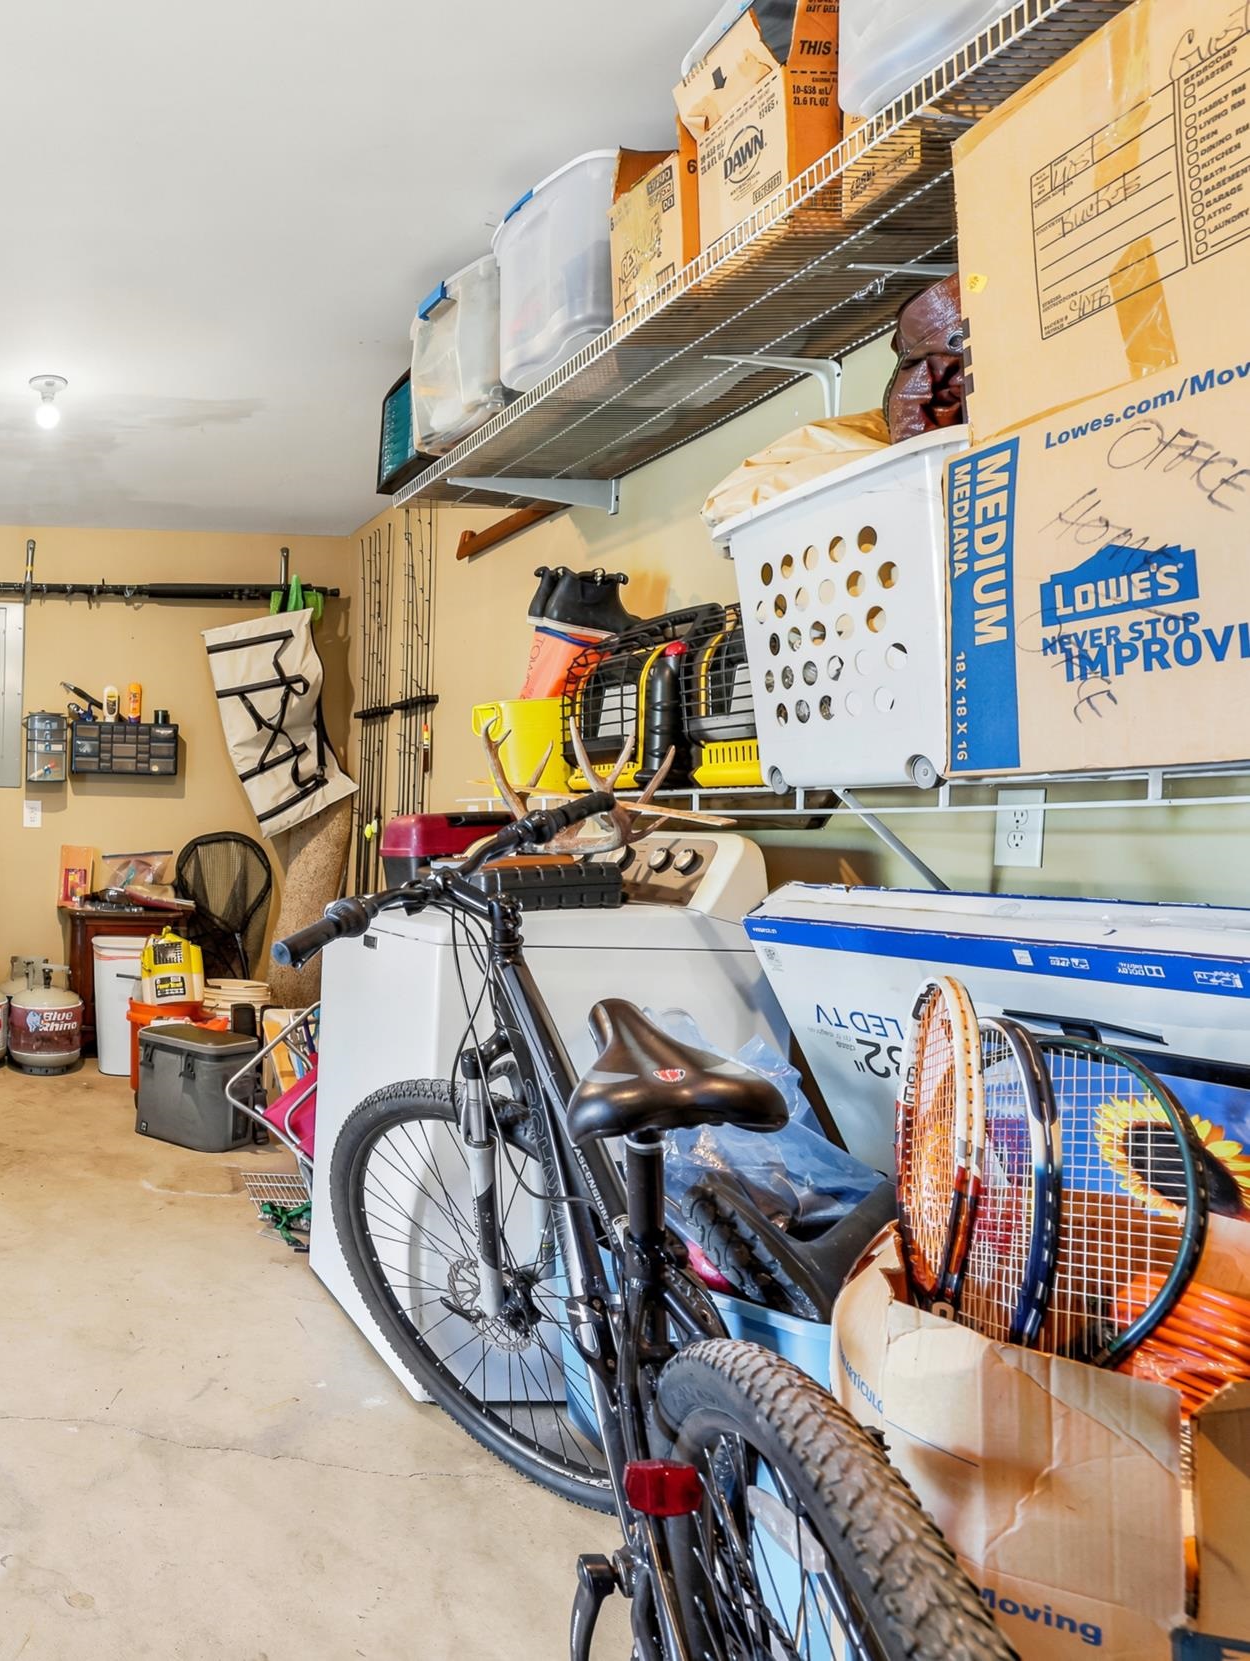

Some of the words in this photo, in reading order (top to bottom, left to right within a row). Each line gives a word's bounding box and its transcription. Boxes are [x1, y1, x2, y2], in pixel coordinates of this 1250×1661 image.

[799, 40, 832, 56] THIS
[1183, 46, 1238, 86] BEDROOMS
[1196, 60, 1233, 88] MASTER
[1198, 93, 1229, 118] FAMILY
[1198, 109, 1229, 131] LIVING
[1199, 128, 1219, 144] DEN
[1199, 133, 1233, 157] DINING
[723, 129, 765, 180] DAWN
[1201, 142, 1242, 170] KITCHEN
[1202, 164, 1227, 183] BATH
[1204, 183, 1244, 209] GARAGE
[1206, 202, 1233, 222] ATTIC
[1208, 208, 1250, 235] LAUNDRY
[952, 462, 972, 579] MEDIANA
[973, 448, 1013, 647] MEDIUM
[1053, 564, 1181, 617] LOWE'S
[1041, 625, 1122, 657] NEVER
[1128, 611, 1201, 642] STOP
[954, 651, 967, 674] 18
[955, 696, 968, 717] 18
[956, 739, 968, 761] 16
[38, 1021, 78, 1032] Rhino
[43, 1011, 73, 1022] Blue
[815, 1003, 848, 1030] TV
[848, 1010, 905, 1041] LED
